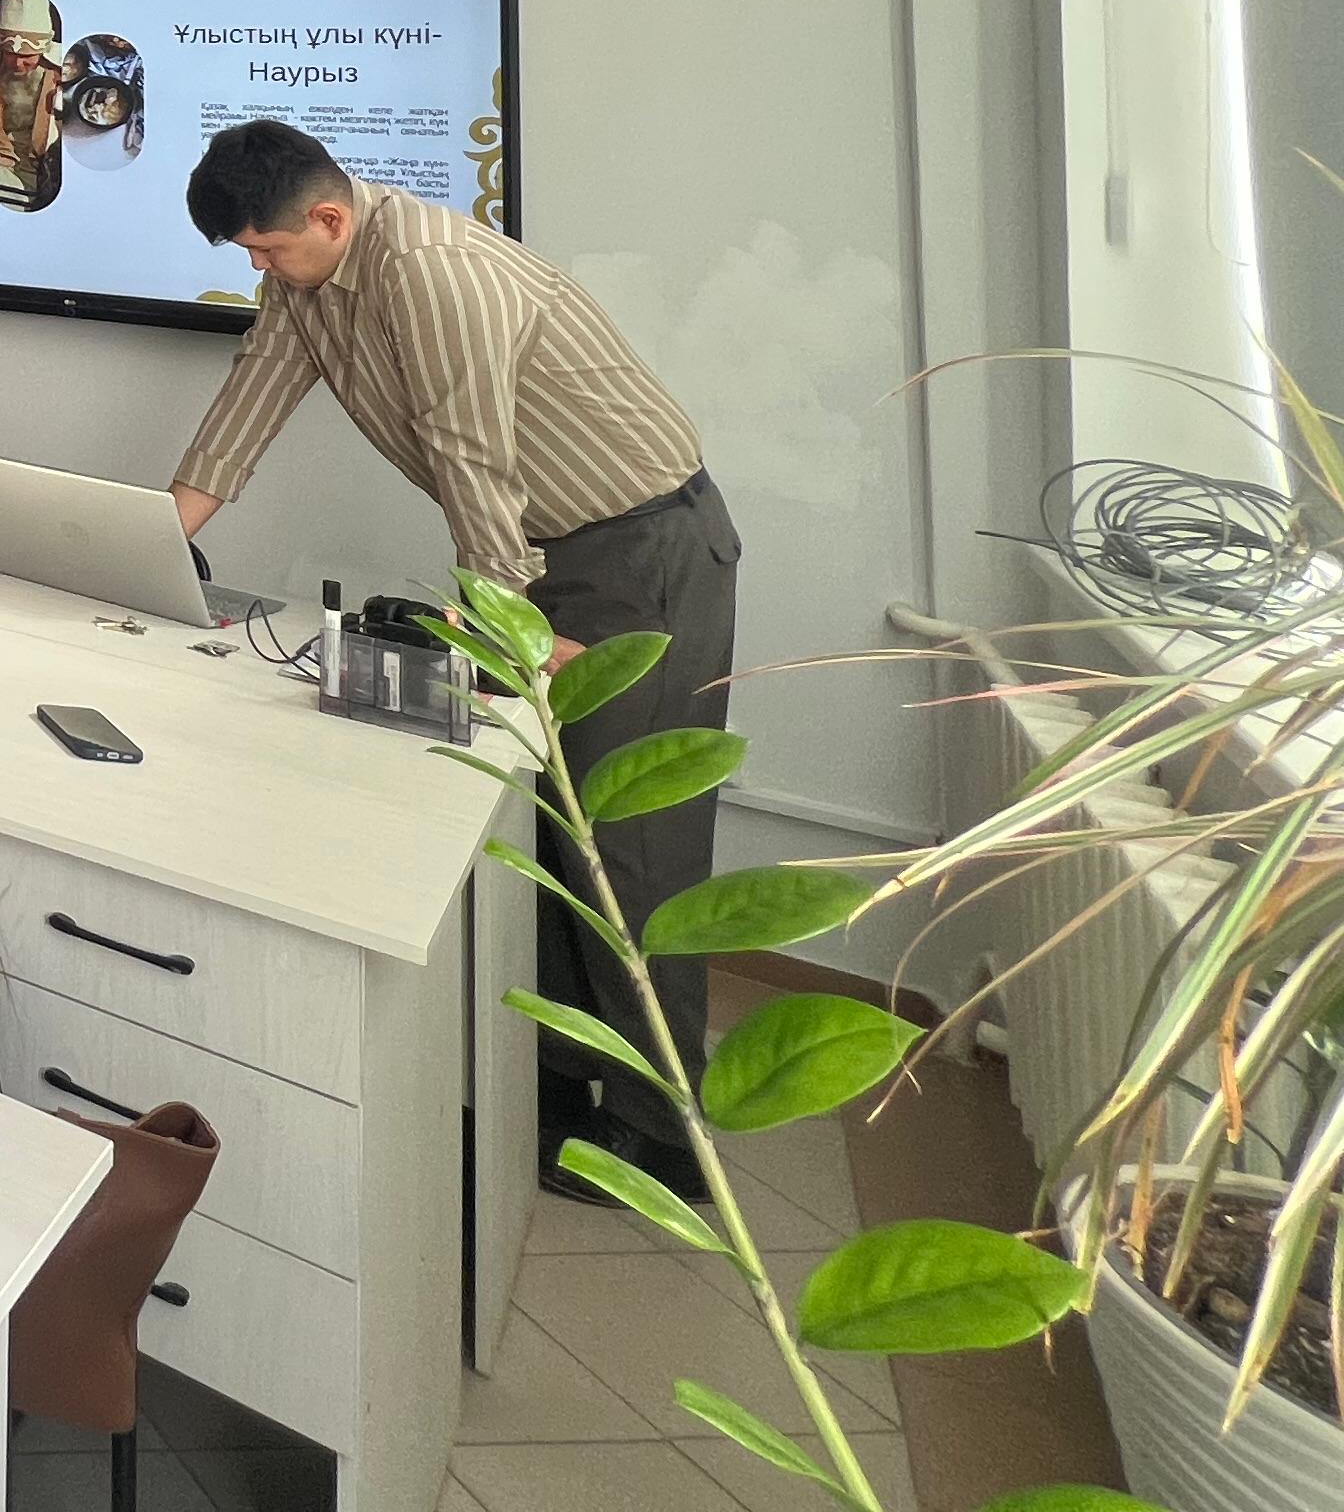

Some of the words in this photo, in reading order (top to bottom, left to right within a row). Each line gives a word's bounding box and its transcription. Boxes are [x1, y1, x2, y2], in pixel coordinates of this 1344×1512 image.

[174, 23, 298, 49] Ұлыстың
[306, 24, 364, 49] ұлы
[374, 22, 443, 49] күні-
[248, 61, 359, 88] Наурыз
